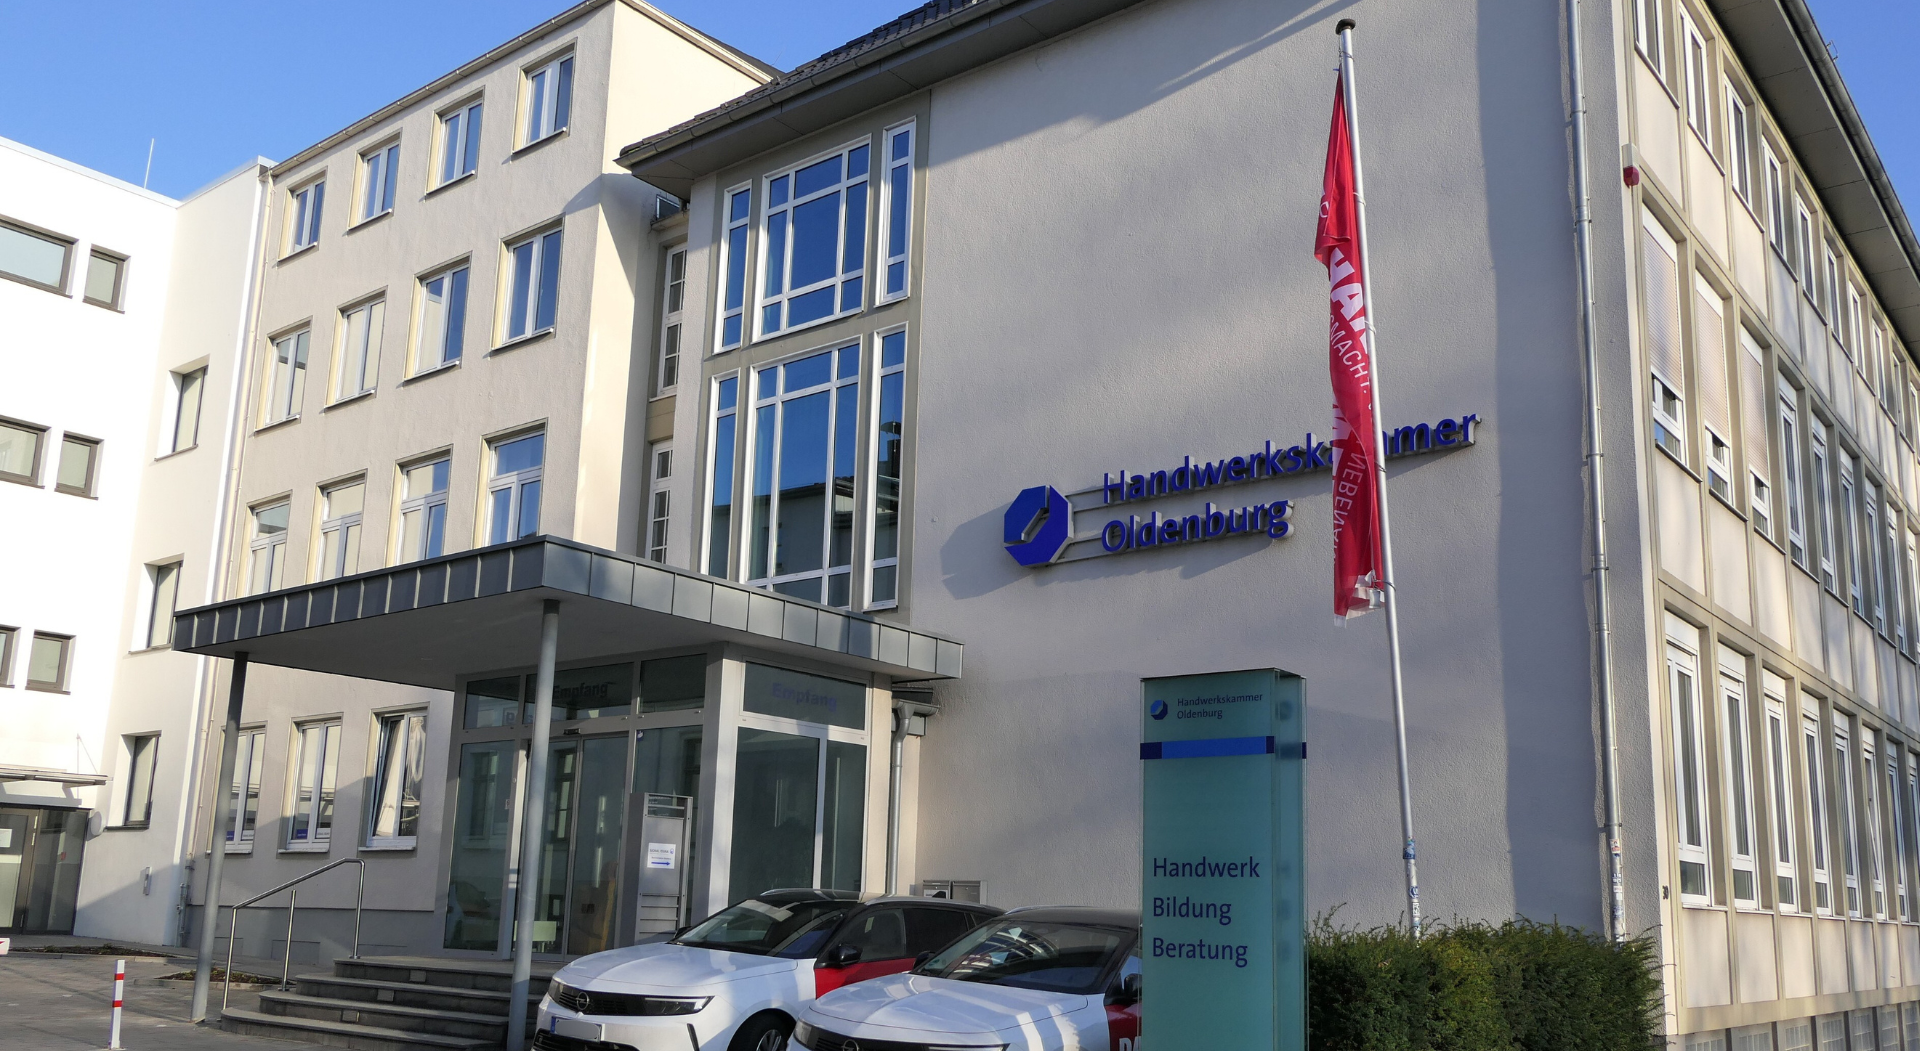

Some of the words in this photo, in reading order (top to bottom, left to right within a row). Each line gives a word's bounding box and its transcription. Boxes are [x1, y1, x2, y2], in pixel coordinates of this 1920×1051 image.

[1103, 414, 1479, 505] Handwerkskmer
[1101, 499, 1290, 553] Oldenburg
[553, 682, 609, 702] Empfang
[772, 682, 837, 713] Empfang
[1177, 694, 1263, 707] Handwerkskammer
[1177, 708, 1223, 720] Oldenburg
[1153, 856, 1261, 878] Handwerk
[1153, 896, 1232, 926] Bildung
[1152, 937, 1248, 968] Beratung
